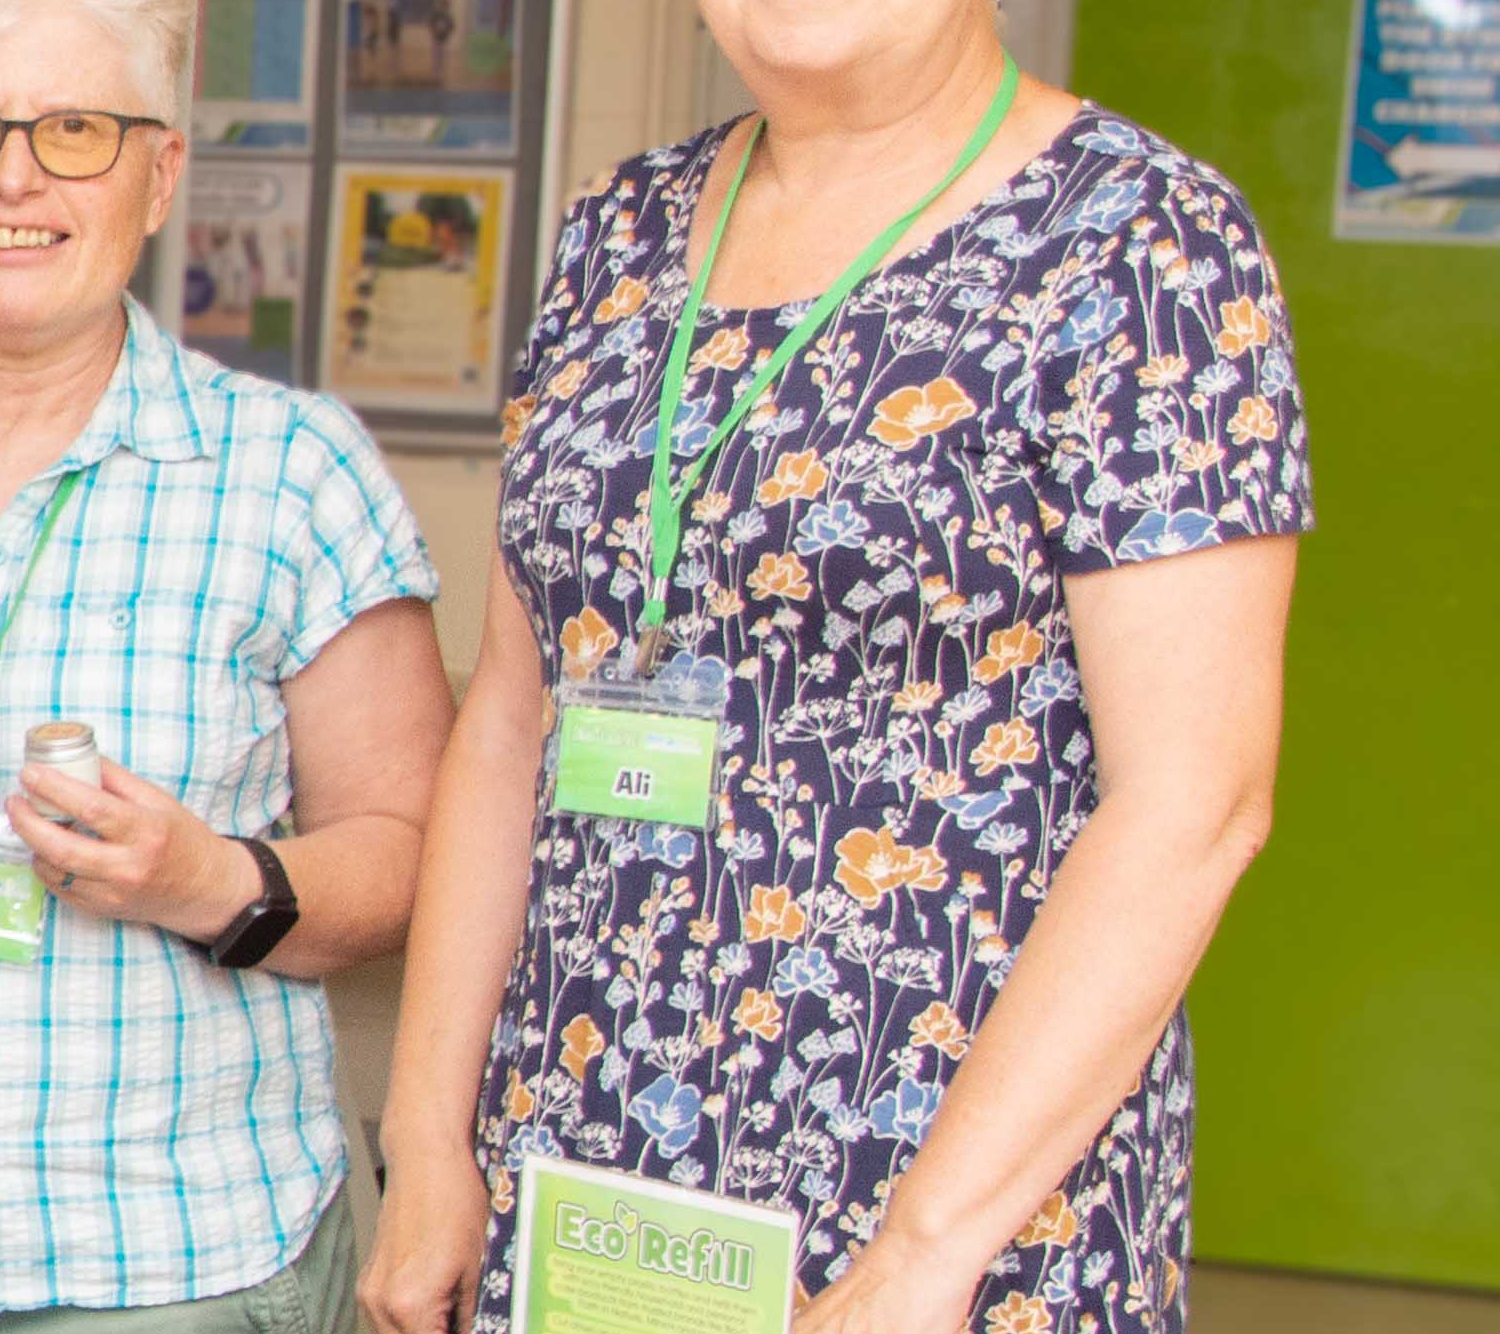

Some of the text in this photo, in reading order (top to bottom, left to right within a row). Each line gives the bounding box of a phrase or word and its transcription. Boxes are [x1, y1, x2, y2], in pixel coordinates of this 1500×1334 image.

[614, 769, 652, 796] Ali
[555, 1202, 756, 1292] Eco Refill
